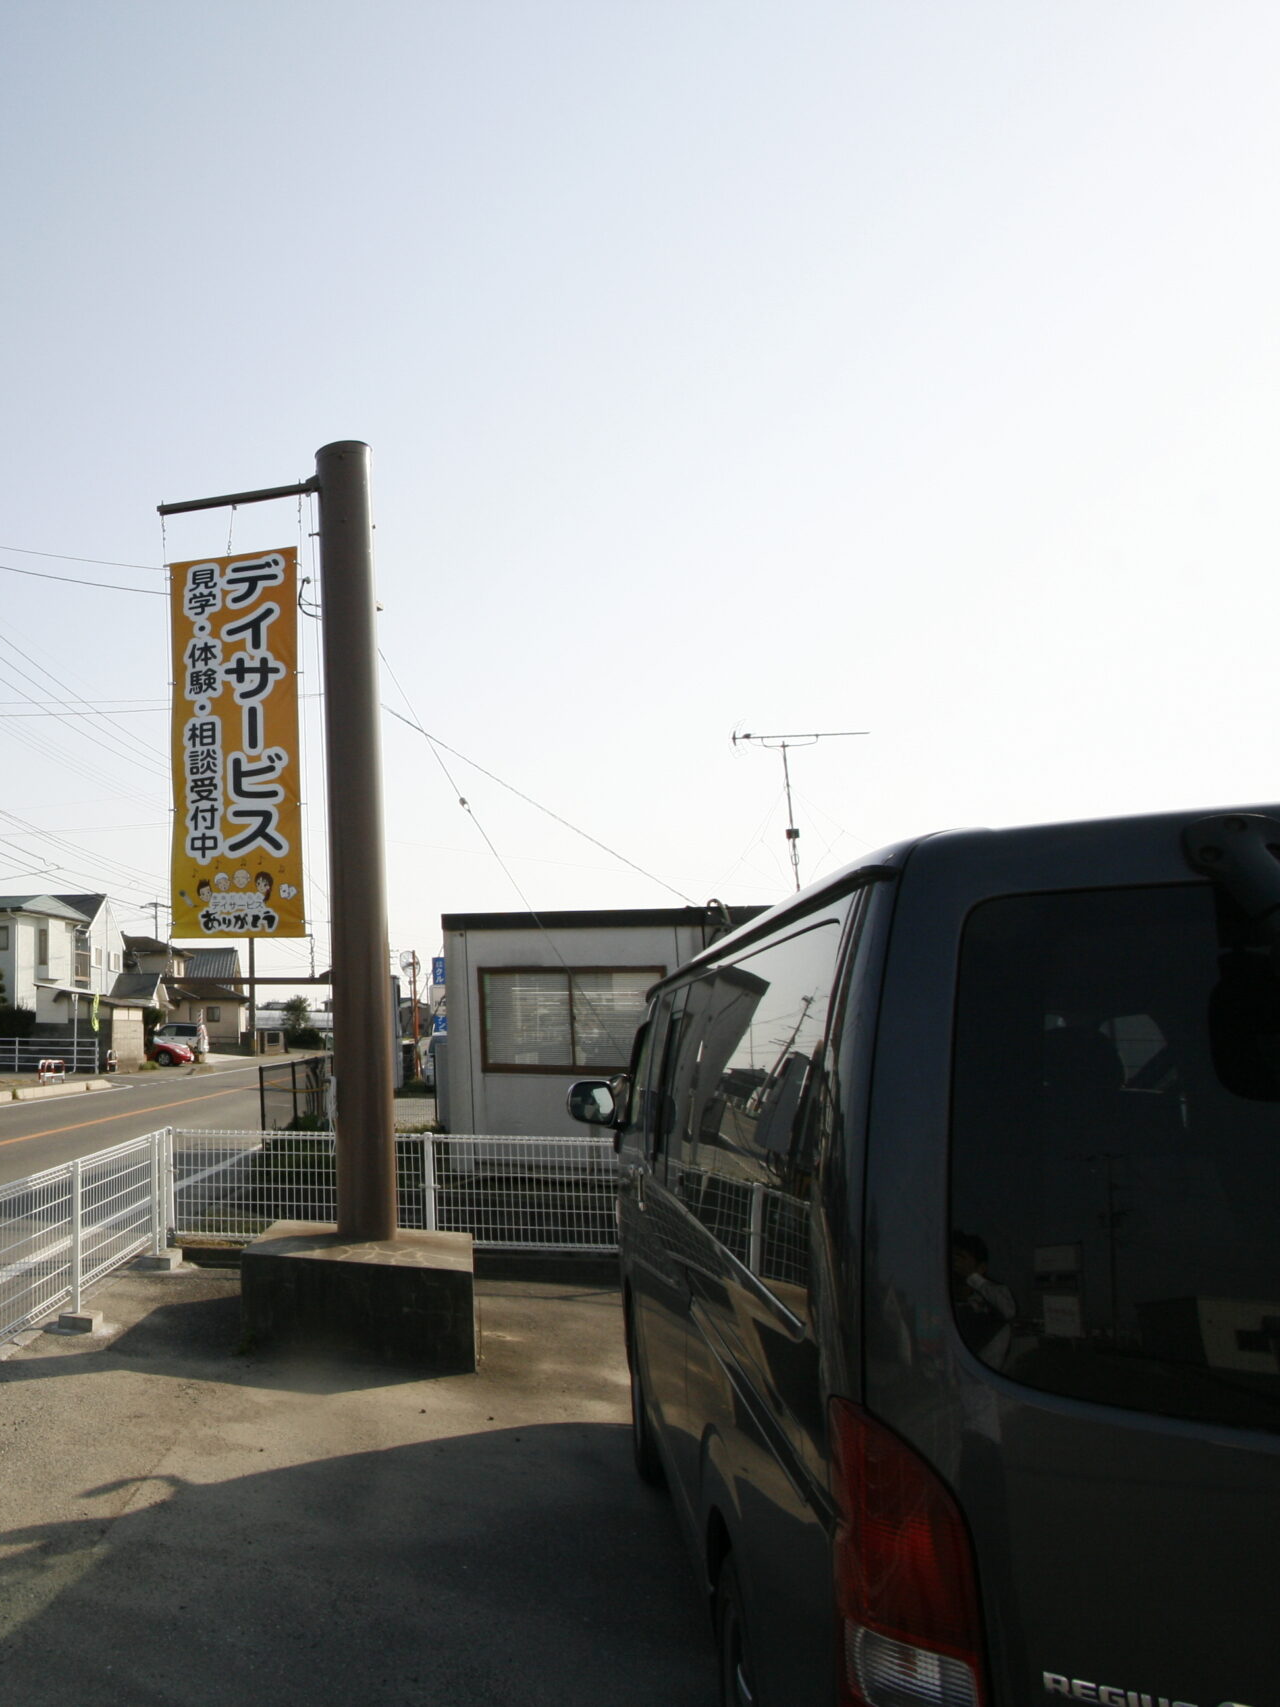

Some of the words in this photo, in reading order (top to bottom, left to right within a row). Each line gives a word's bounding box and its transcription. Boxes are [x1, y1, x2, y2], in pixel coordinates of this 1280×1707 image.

[187, 568, 218, 859] 見学・体験・相談受付中
[224, 558, 283, 852] デイサービス
[200, 909, 276, 931] ありがとう
[1043, 1671, 1198, 1707] REGI
